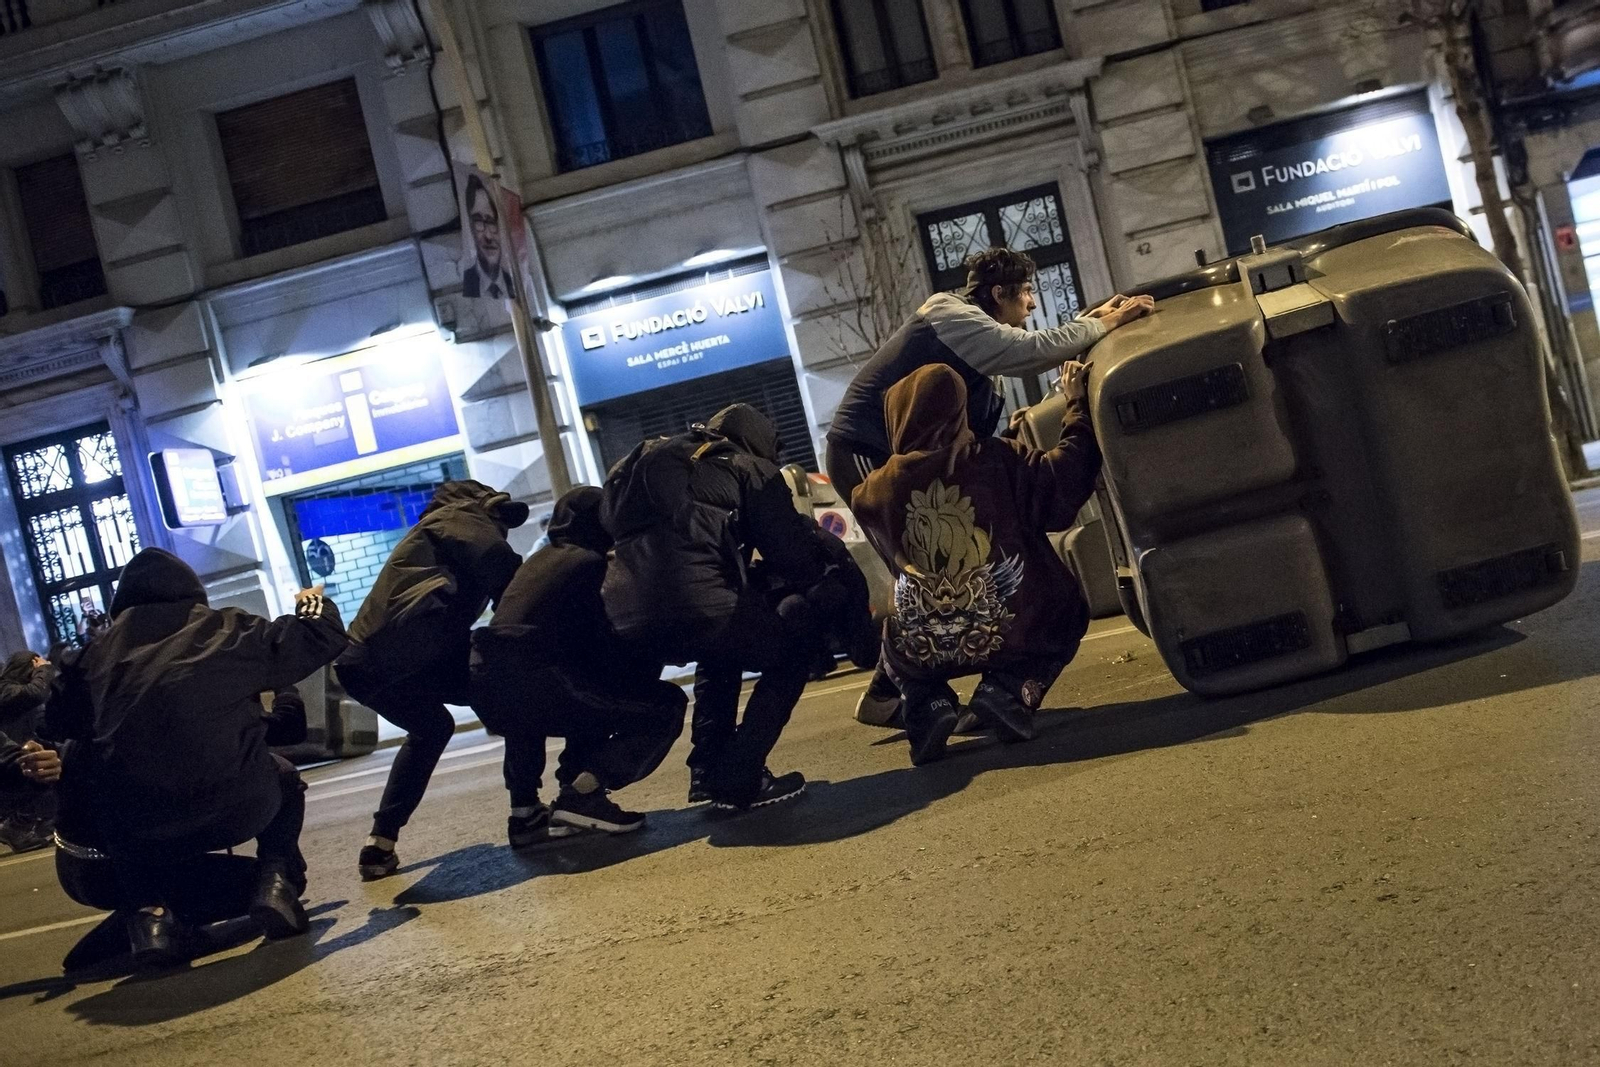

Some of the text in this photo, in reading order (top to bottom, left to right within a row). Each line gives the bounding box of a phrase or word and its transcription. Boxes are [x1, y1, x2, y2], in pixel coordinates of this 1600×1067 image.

[1266, 201, 1294, 215] SALA
[1294, 191, 1337, 209] MIQUEL
[1135, 241, 1152, 256] 42
[610, 291, 766, 343] FUNDACIÓ VALVI
[626, 334, 731, 368] SALA MERCÈ HUERTA
[270, 428, 284, 443] J.
